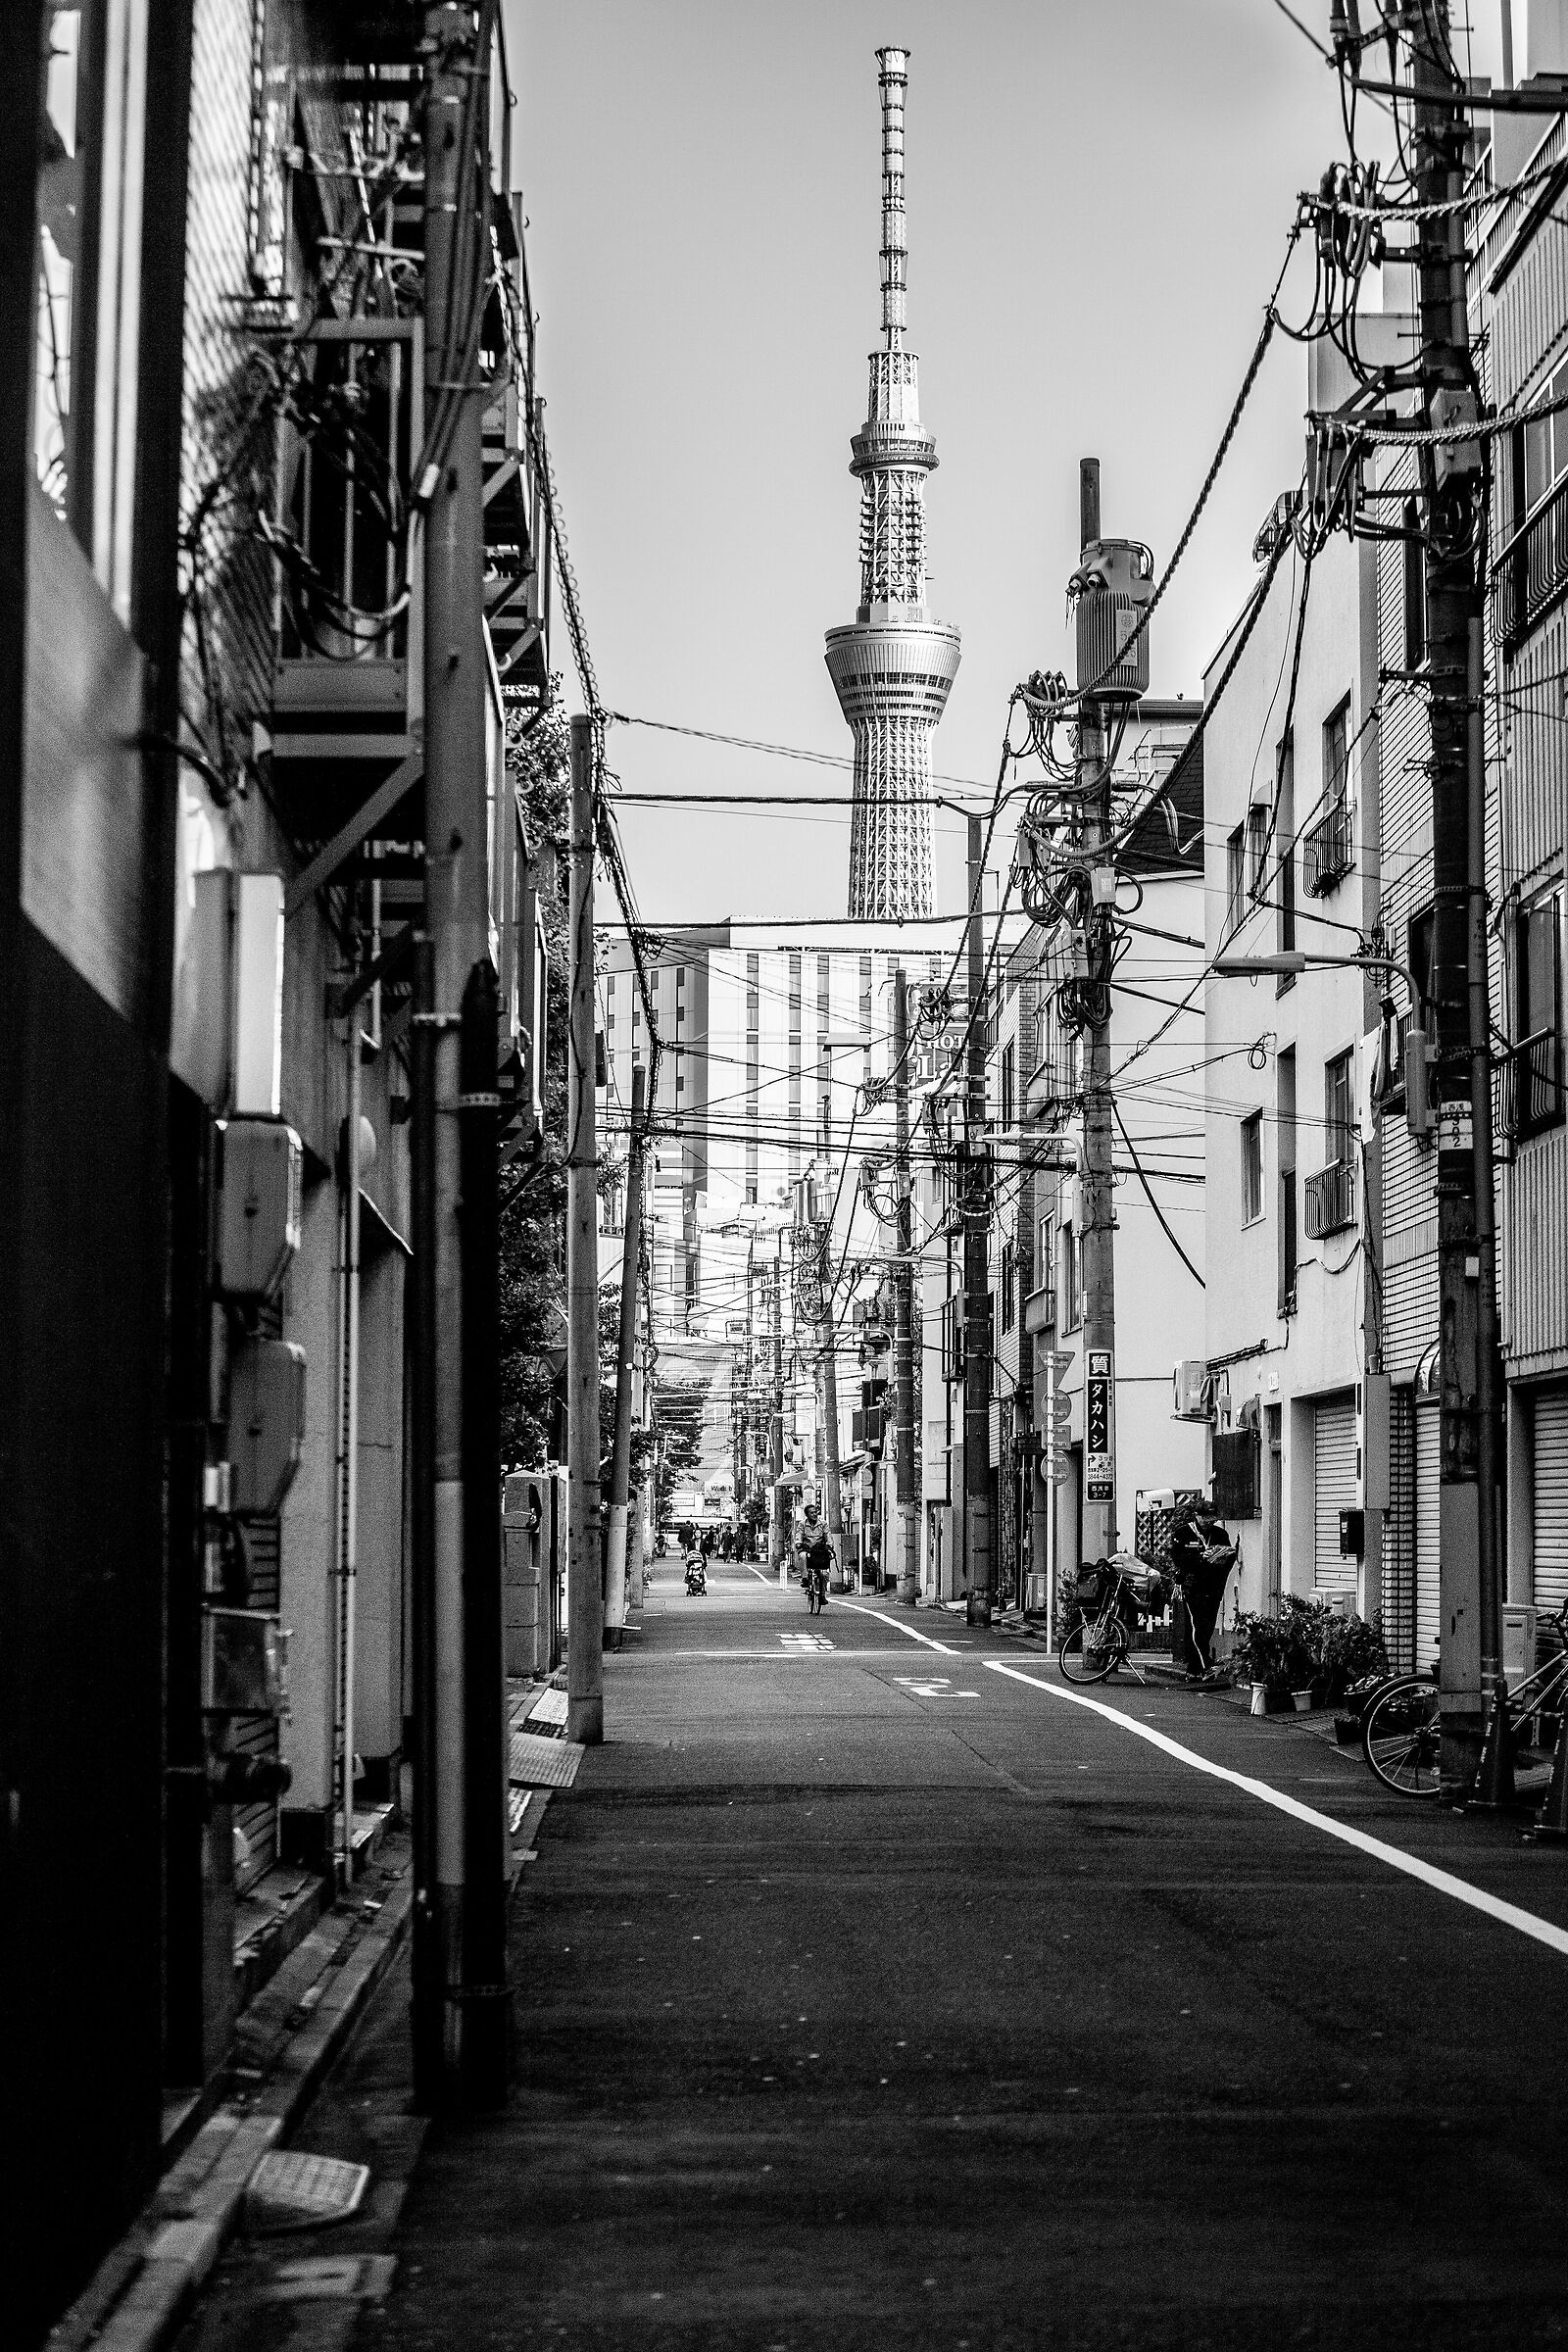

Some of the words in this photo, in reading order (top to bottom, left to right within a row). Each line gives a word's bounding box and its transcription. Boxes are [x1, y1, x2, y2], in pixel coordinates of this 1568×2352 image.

[1091, 1355, 1109, 1374] 質
[1090, 1383, 1104, 1448] タカハシ
